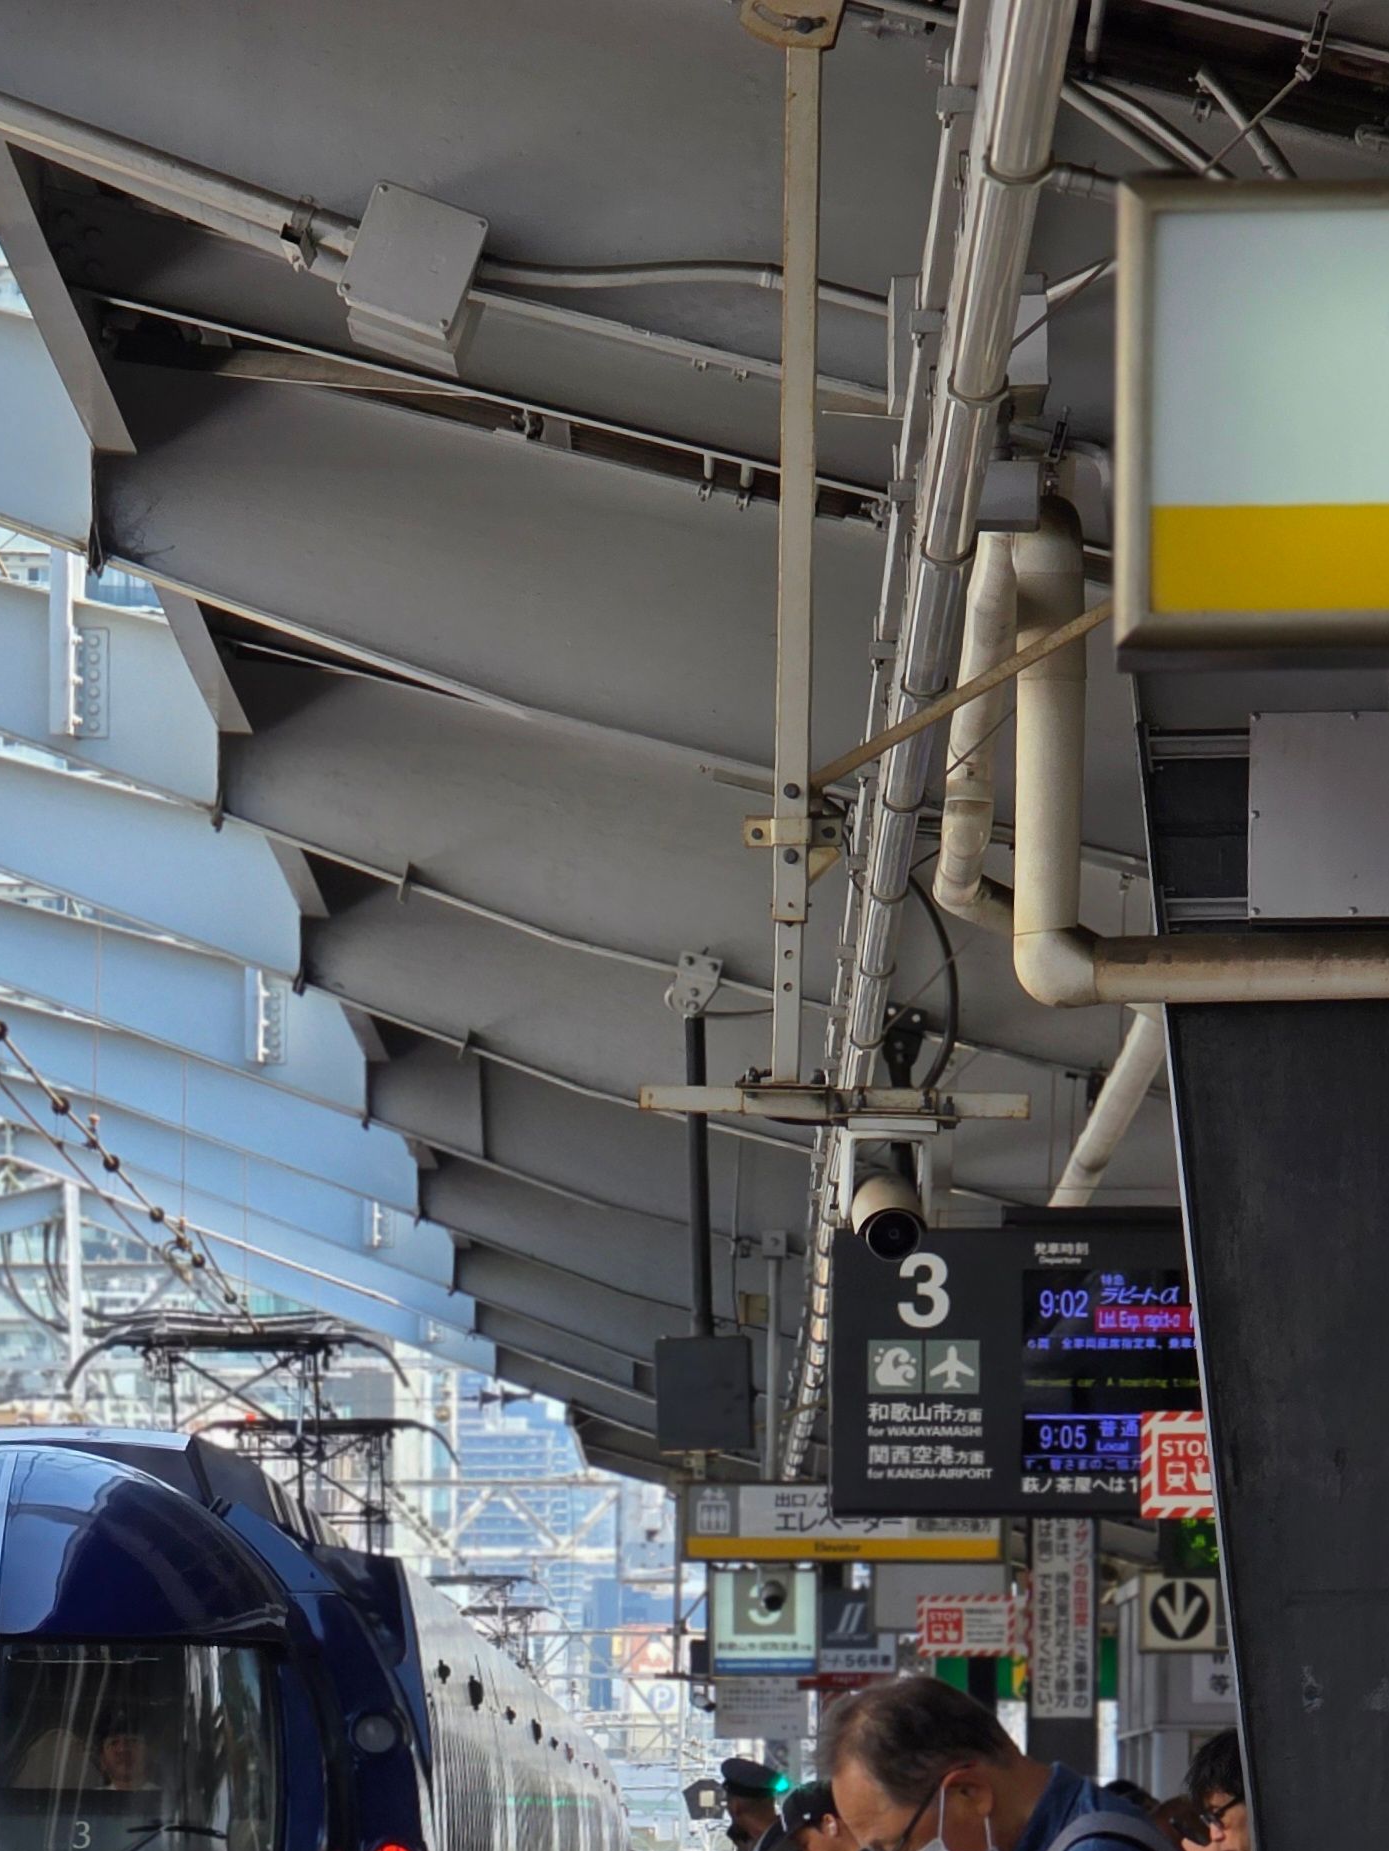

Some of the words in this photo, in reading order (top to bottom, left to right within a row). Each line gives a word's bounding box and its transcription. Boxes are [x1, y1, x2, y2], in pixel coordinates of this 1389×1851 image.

[1035, 1242, 1089, 1255] 発車時刻
[1039, 1256, 1082, 1264] Departure
[897, 1252, 950, 1328] 3
[1040, 1290, 1089, 1318] 9:02
[868, 1403, 983, 1422] 和歌山市方面
[867, 1426, 885, 1437] for
[887, 1426, 983, 1437] WAKAYAMASHI
[1040, 1425, 1087, 1449] 9:05
[1099, 1419, 1139, 1437] 普通
[868, 1445, 985, 1465] 関西空港方面
[1097, 1441, 1129, 1452] Local
[867, 1468, 885, 1479] for
[887, 1468, 993, 1479] KANSAI-AIRPORT
[814, 1542, 861, 1552] Elevator
[72, 1821, 91, 1849] 3
